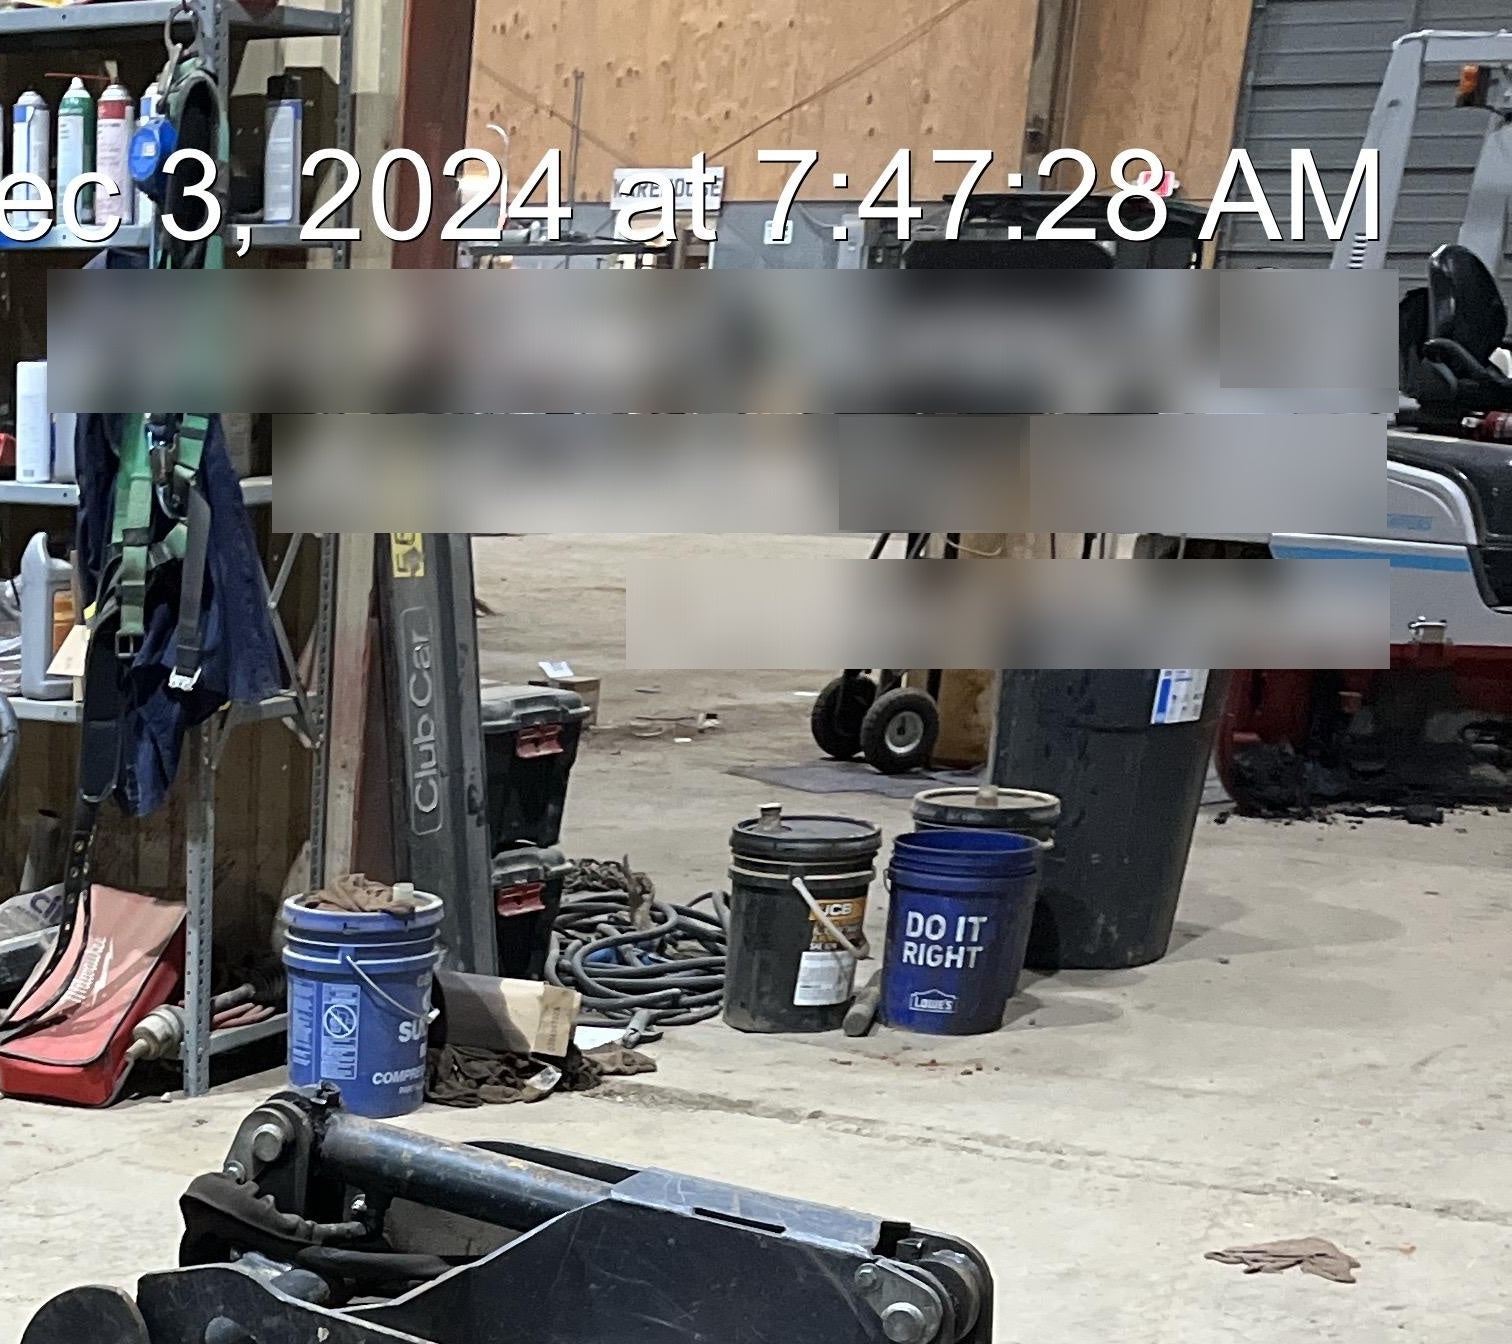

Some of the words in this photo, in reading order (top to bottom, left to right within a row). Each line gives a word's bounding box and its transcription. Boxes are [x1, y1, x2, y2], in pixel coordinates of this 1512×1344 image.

[906, 910, 947, 941] DO
[955, 915, 988, 942] IT
[902, 941, 985, 969] RIGHT
